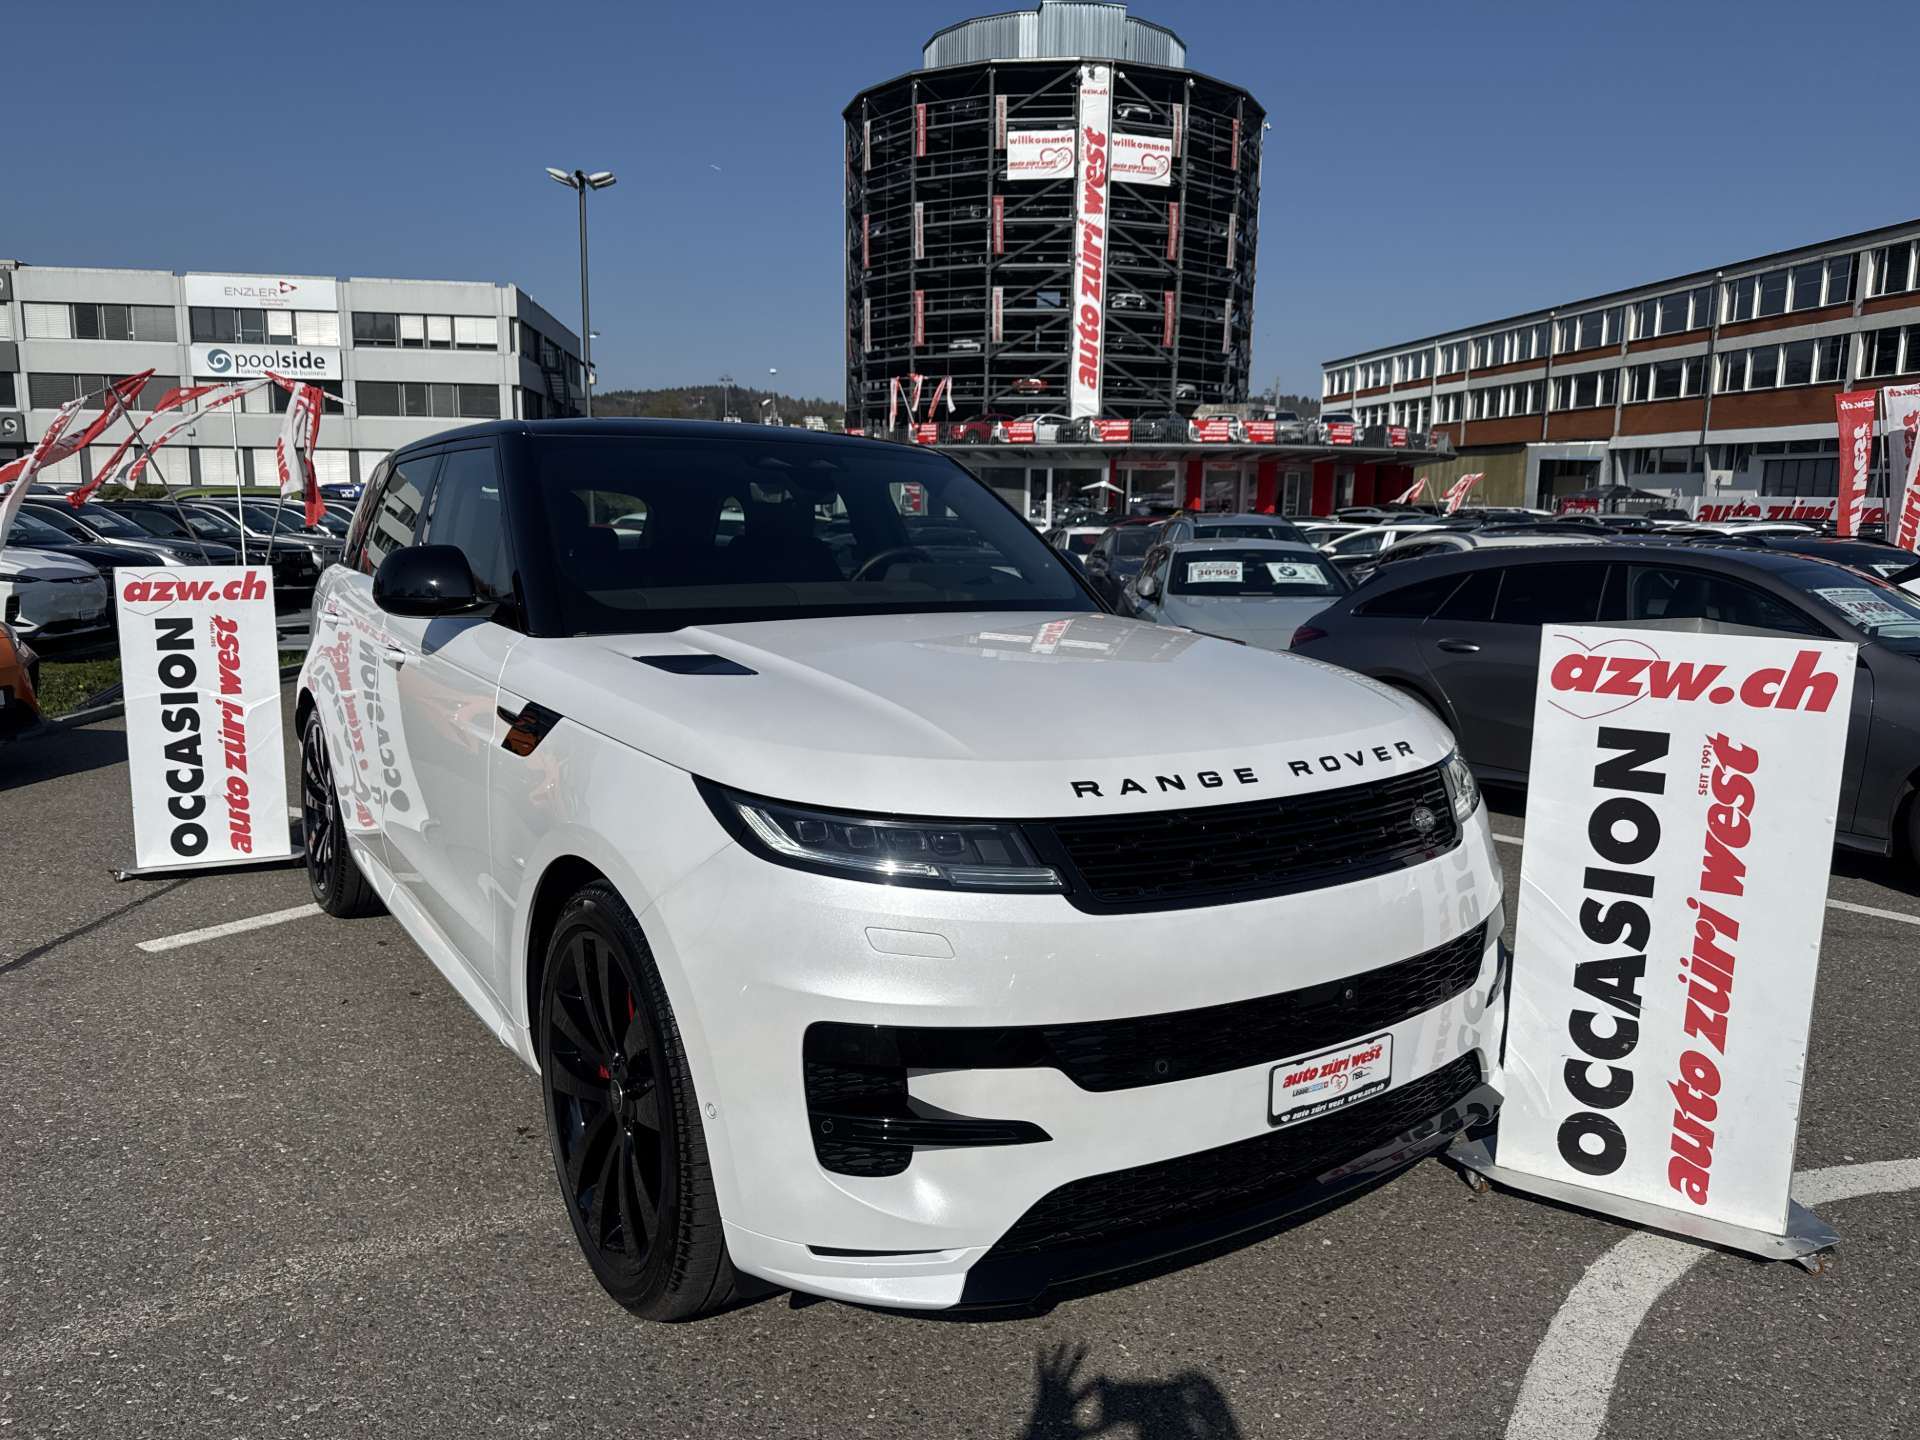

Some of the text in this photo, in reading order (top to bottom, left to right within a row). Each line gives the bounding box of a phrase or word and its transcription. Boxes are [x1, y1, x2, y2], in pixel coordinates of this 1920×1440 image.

[1009, 135, 1073, 145] willkommen
[1112, 138, 1170, 151] willkommen
[1076, 126, 1106, 389] auto züri west
[224, 286, 277, 297] ENZLER
[235, 350, 326, 374] poolside
[1696, 497, 1762, 522] auto
[123, 571, 267, 602] azw.ch
[1550, 650, 1839, 713] azw.ch
[155, 617, 209, 857] OCCASION
[211, 614, 252, 854] auto züri west
[1070, 740, 1416, 798] RANGE ROVER
[1698, 744, 1712, 796] SEIT 1991
[1557, 726, 1671, 1176] OCCASION
[1667, 732, 1759, 1206] auto züri west
[1283, 1066, 1319, 1089] auto
[1319, 1054, 1351, 1079] züri
[1352, 1045, 1383, 1068] west
[1292, 1109, 1310, 1120] auto
